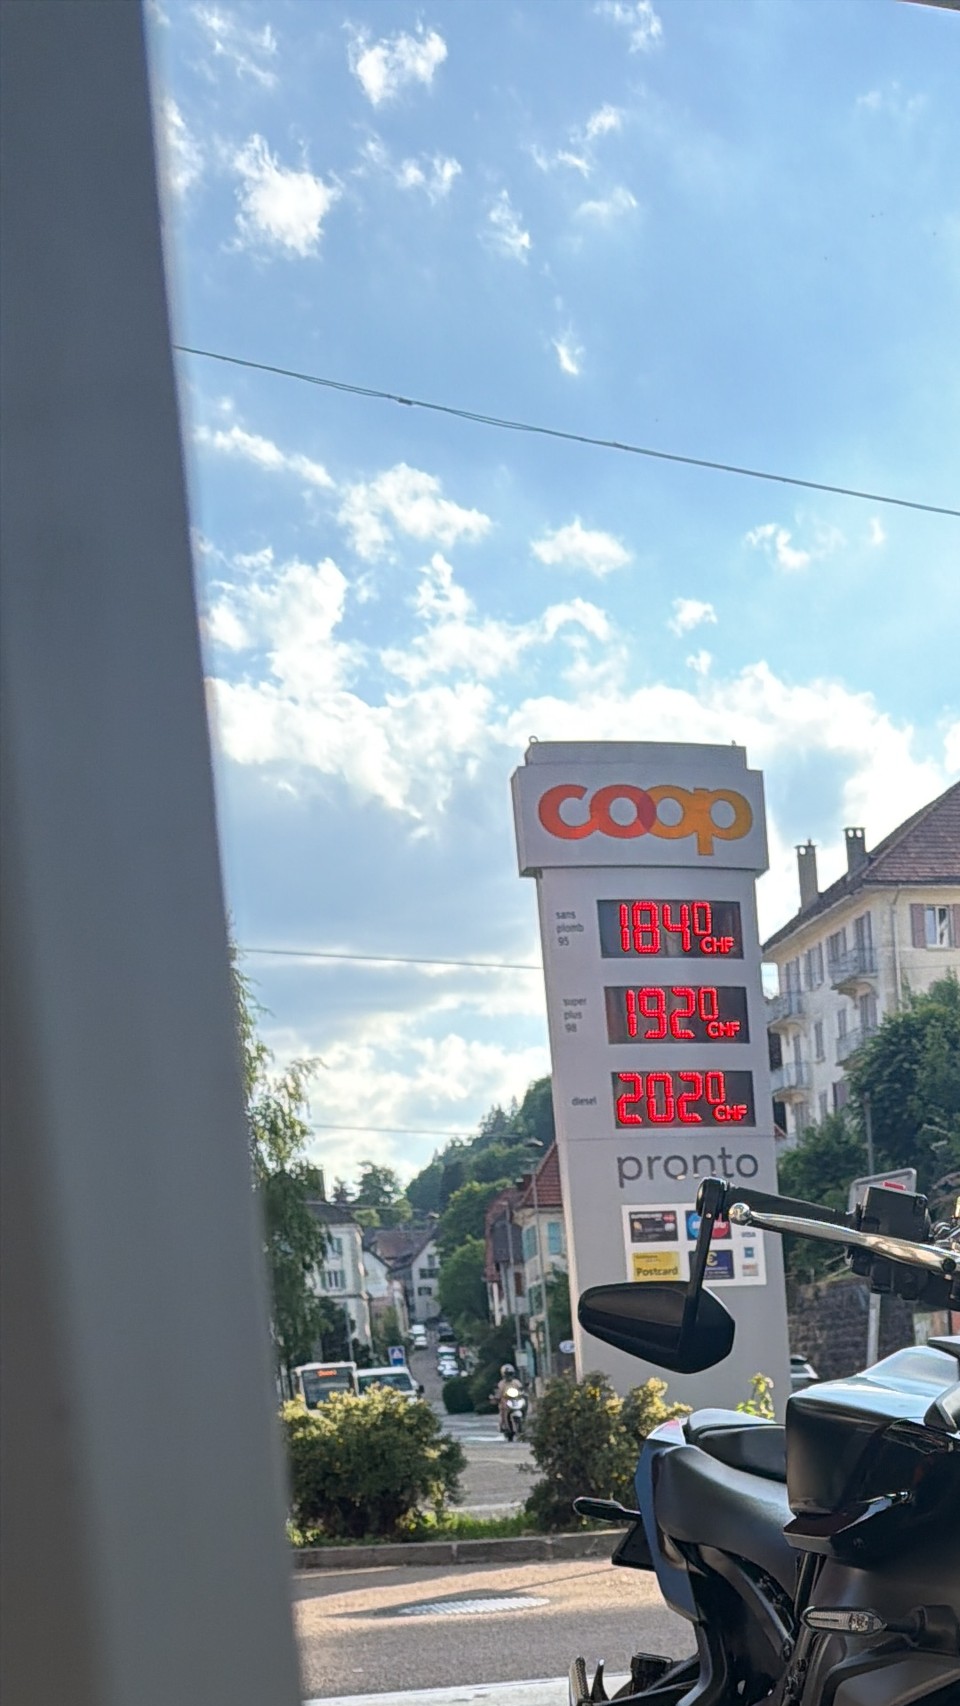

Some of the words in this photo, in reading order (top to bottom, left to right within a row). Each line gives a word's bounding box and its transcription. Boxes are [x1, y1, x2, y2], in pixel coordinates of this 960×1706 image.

[538, 784, 753, 856] coop
[556, 911, 576, 919] sans
[556, 923, 584, 934] plomb
[558, 936, 569, 946] 95
[701, 936, 735, 954] CHF
[564, 1010, 582, 1020] plus
[706, 1021, 741, 1038] CHF
[571, 1096, 597, 1106] diesel
[713, 1104, 748, 1121] CHF
[617, 1146, 758, 1188] pronto
[636, 1267, 678, 1278] Postcard
